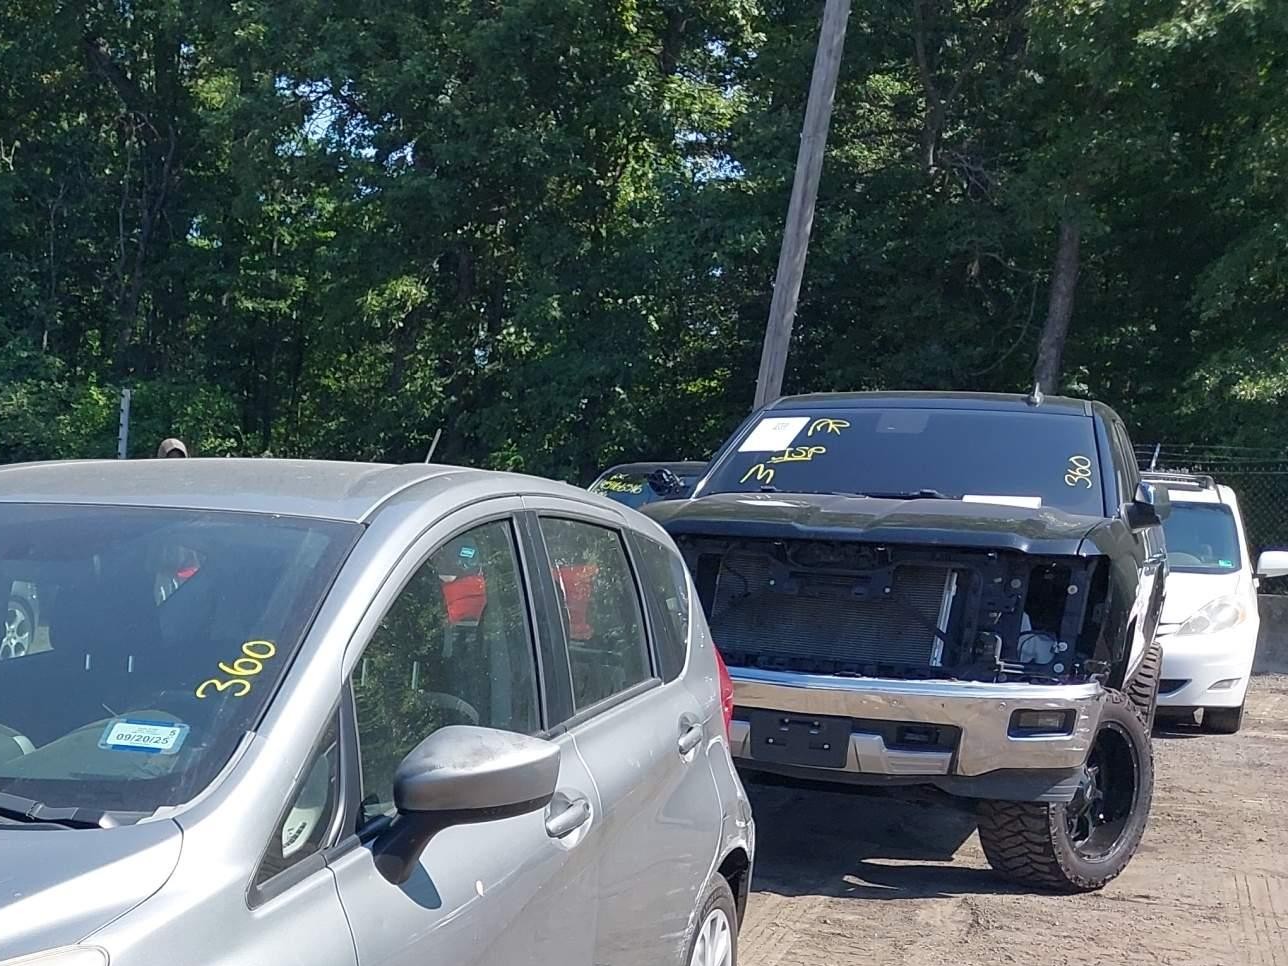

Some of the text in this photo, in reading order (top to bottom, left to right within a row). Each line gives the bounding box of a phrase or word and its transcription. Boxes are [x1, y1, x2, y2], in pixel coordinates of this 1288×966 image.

[740, 463, 775, 484] M
[1065, 455, 1092, 489] 360
[196, 640, 276, 698] 360
[116, 733, 169, 745] 09/20/25
